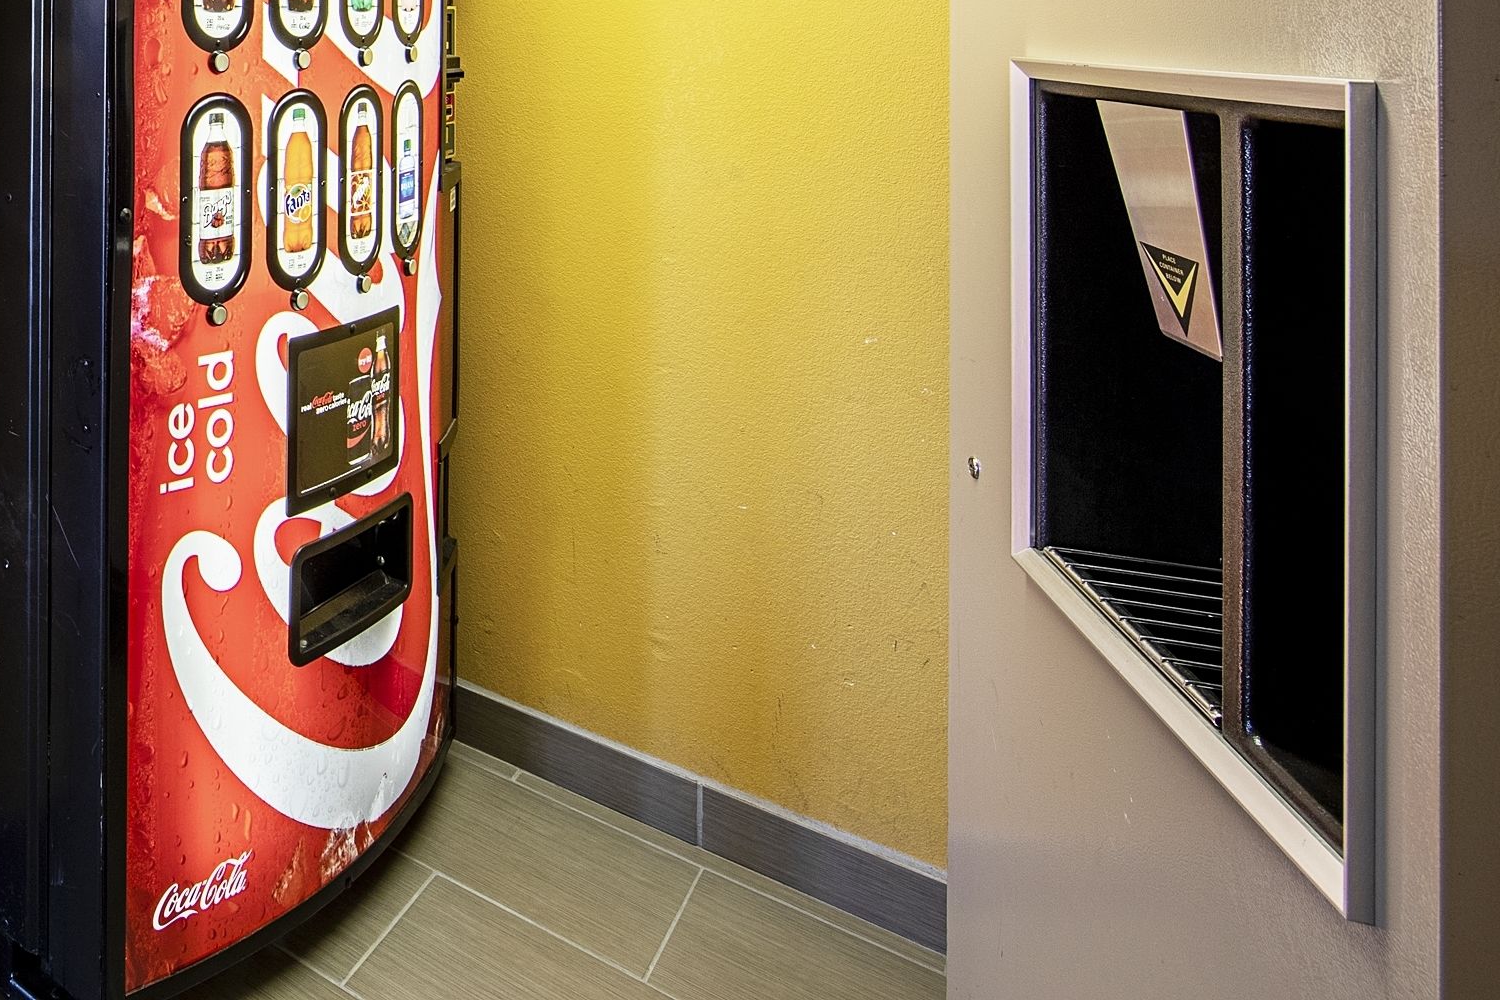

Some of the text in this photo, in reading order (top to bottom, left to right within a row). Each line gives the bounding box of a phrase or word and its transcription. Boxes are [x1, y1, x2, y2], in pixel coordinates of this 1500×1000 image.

[1162, 253, 1176, 264] PLACE
[1159, 261, 1184, 276] CONTAINER
[1165, 272, 1182, 284] BELOW
[300, 402, 312, 413] real
[333, 392, 345, 402] taste
[315, 405, 329, 415] zero
[197, 350, 235, 485] cold
[352, 420, 367, 432] zero
[159, 402, 196, 495] ice
[152, 848, 253, 931] Coca-Cola
